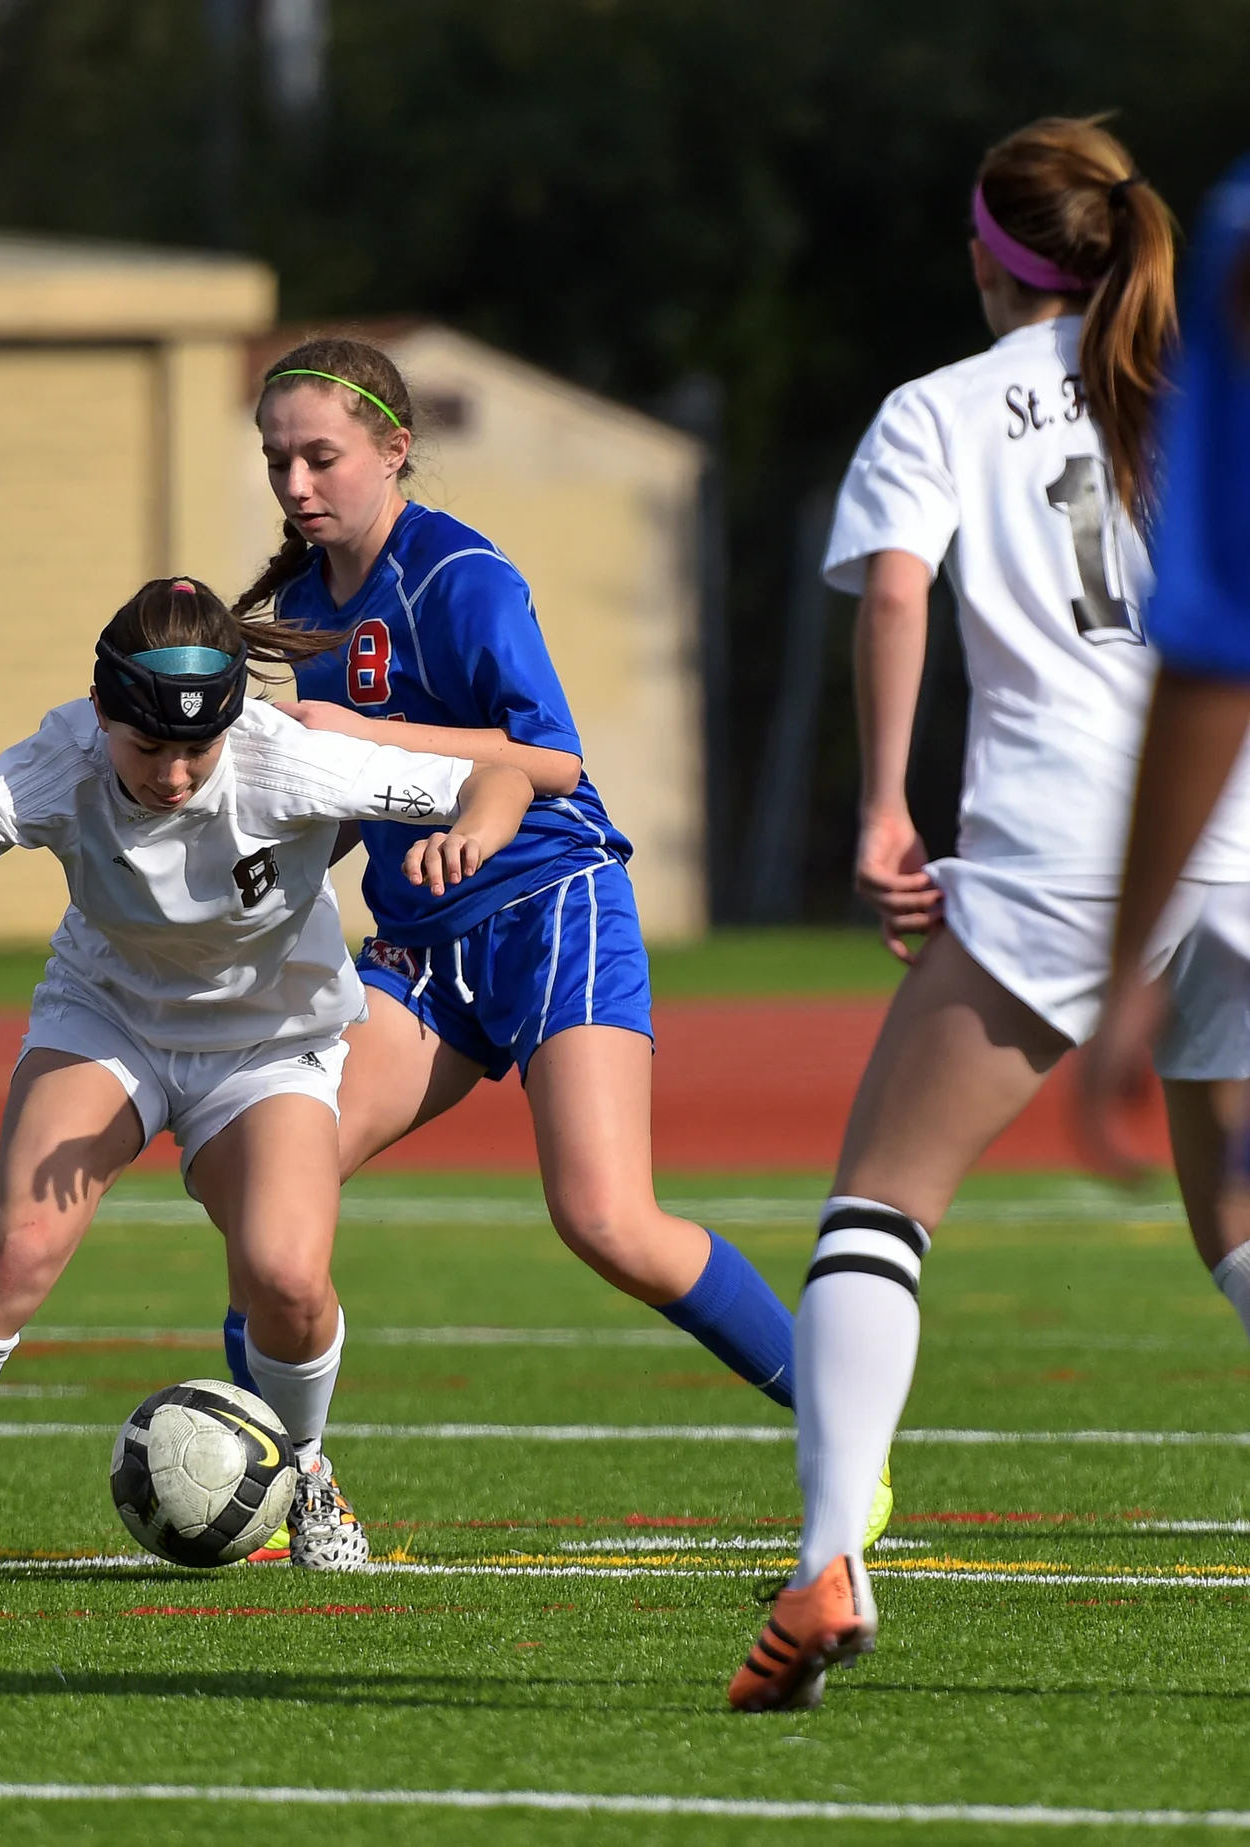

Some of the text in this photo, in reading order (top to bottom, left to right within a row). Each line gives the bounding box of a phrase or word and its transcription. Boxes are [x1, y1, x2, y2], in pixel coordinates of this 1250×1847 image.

[1005, 384, 1055, 441] St.
[347, 618, 392, 707] 8
[231, 846, 281, 910] 8
